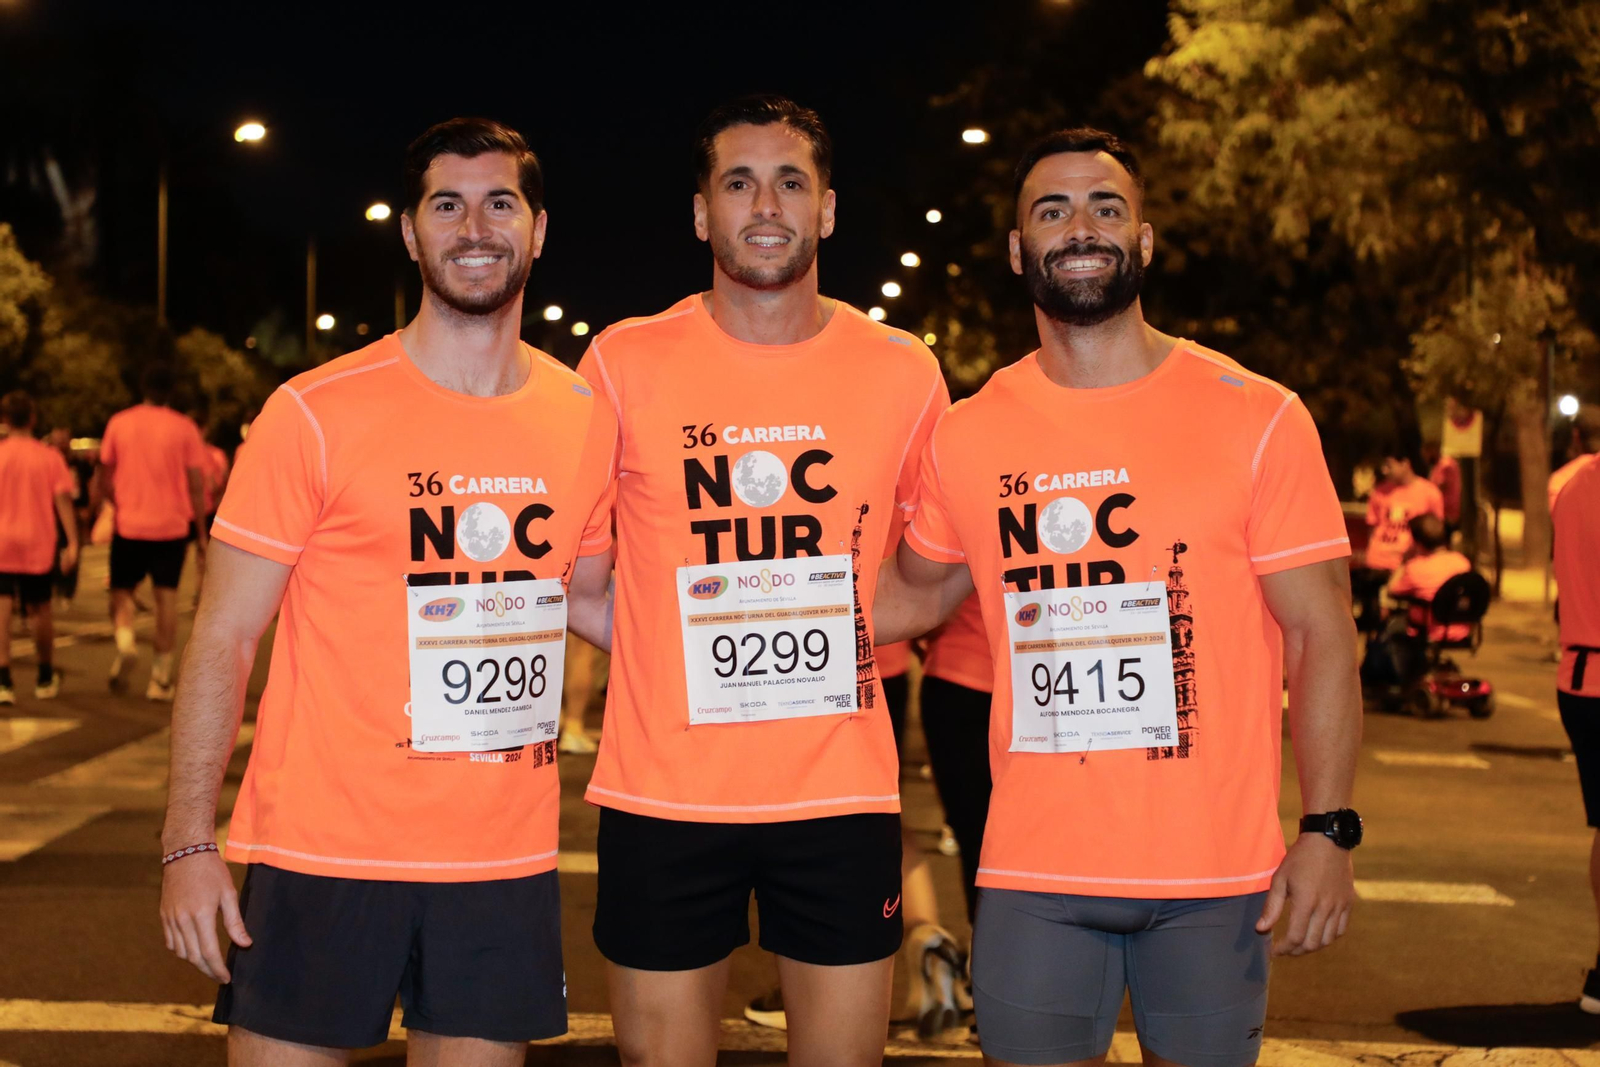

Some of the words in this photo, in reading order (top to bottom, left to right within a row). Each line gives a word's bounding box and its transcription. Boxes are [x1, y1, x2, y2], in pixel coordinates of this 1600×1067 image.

[682, 423, 717, 449] 36
[722, 424, 826, 445] CARRERA
[407, 471, 444, 498] 36
[449, 474, 548, 495] CARRERA
[999, 471, 1029, 498] 36
[1033, 467, 1130, 493] CARRERA
[690, 514, 824, 565] TUR
[810, 571, 845, 580] #BEACTIVE
[1122, 598, 1160, 608] #BEACTIVE
[776, 609, 819, 617] GUADALQUIVIR
[469, 637, 499, 645] NOCTURNA
[499, 636, 508, 644] DEL
[1087, 637, 1133, 645] GUADALQUIVIR
[712, 629, 830, 678] 9299
[442, 654, 547, 705] 9298
[737, 680, 762, 688] MANUEL
[763, 678, 796, 687] PALACIOS
[796, 675, 826, 684] NOVALIO
[1031, 657, 1146, 707] 9415
[824, 693, 851, 703] POWER
[464, 708, 489, 716] DANIEL
[489, 706, 511, 714] MENDEZ
[511, 704, 533, 713] GAMBOA
[697, 706, 733, 715] Cruzcampo
[1061, 708, 1096, 717] MENDOZA
[1096, 706, 1141, 715] BOCANEGRA
[536, 720, 556, 730] POWER
[1141, 725, 1171, 735] POWER
[421, 733, 461, 742] Cruzcampo
[1018, 735, 1049, 743] Cruzcampo
[1155, 732, 1172, 740] ADE
[469, 752, 504, 764] SEVILLA
